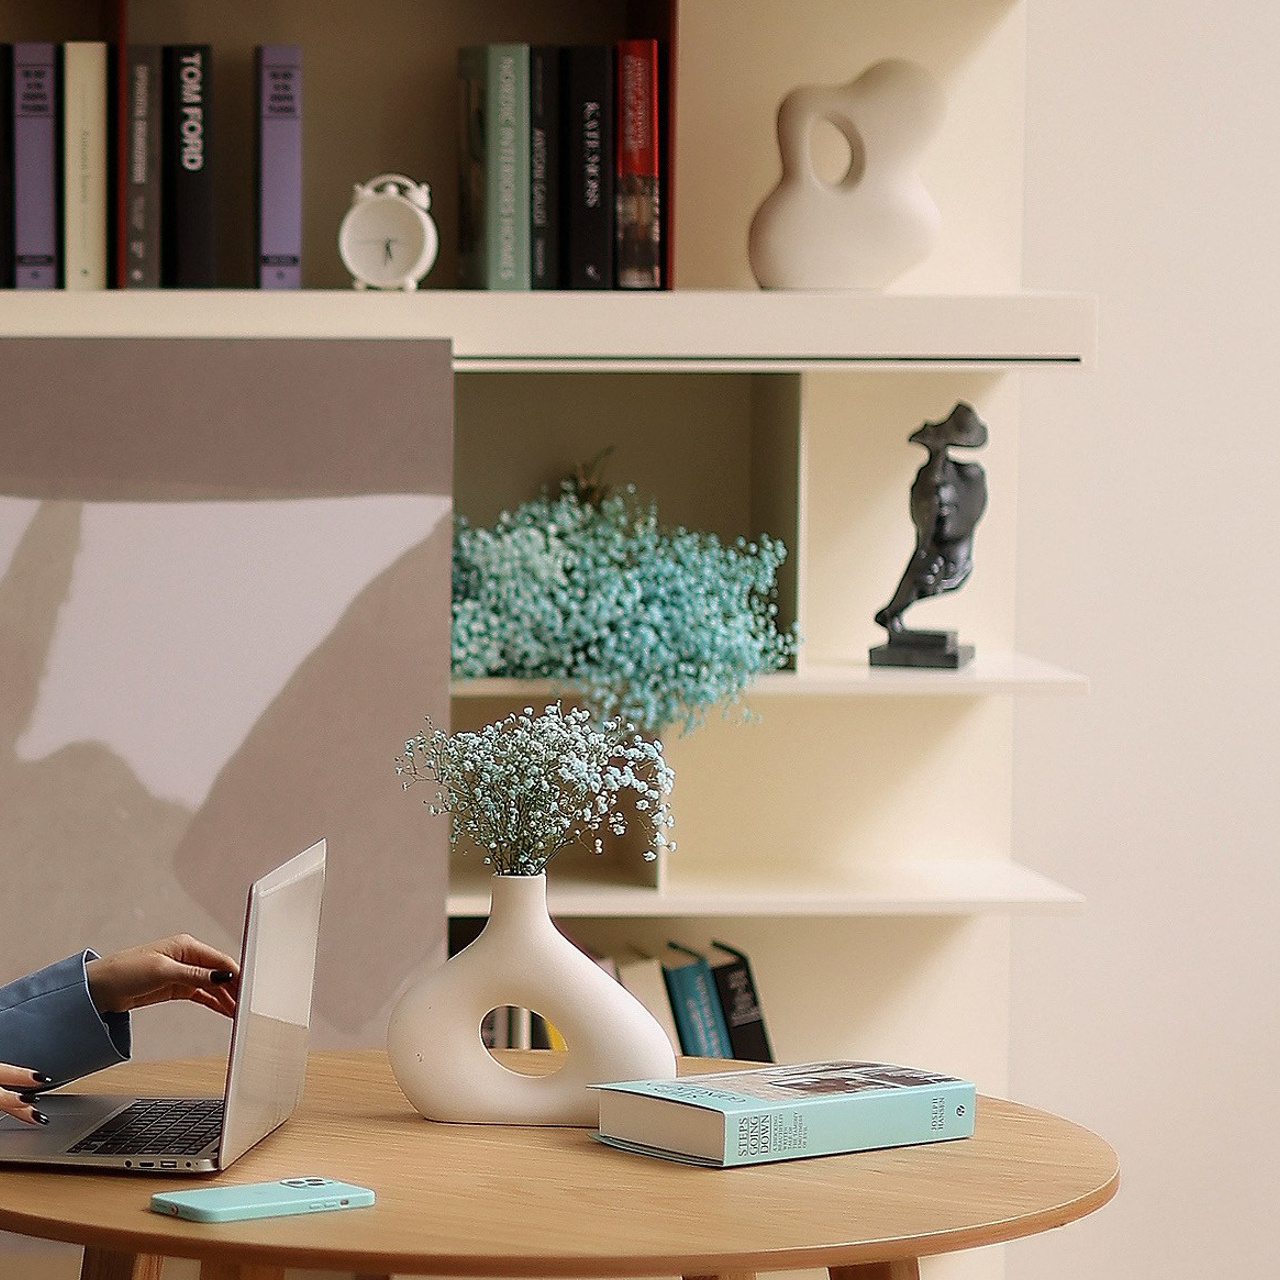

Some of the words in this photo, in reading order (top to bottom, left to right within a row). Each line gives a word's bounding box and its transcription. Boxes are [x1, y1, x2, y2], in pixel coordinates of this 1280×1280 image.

[181, 52, 203, 104] TOM
[181, 106, 203, 171] FORD
[583, 101, 600, 151] KATE
[583, 152, 600, 209] MOSS
[738, 1117, 748, 1157] STEPS
[749, 1116, 759, 1156] GOING
[760, 1114, 769, 1154] DOWN
